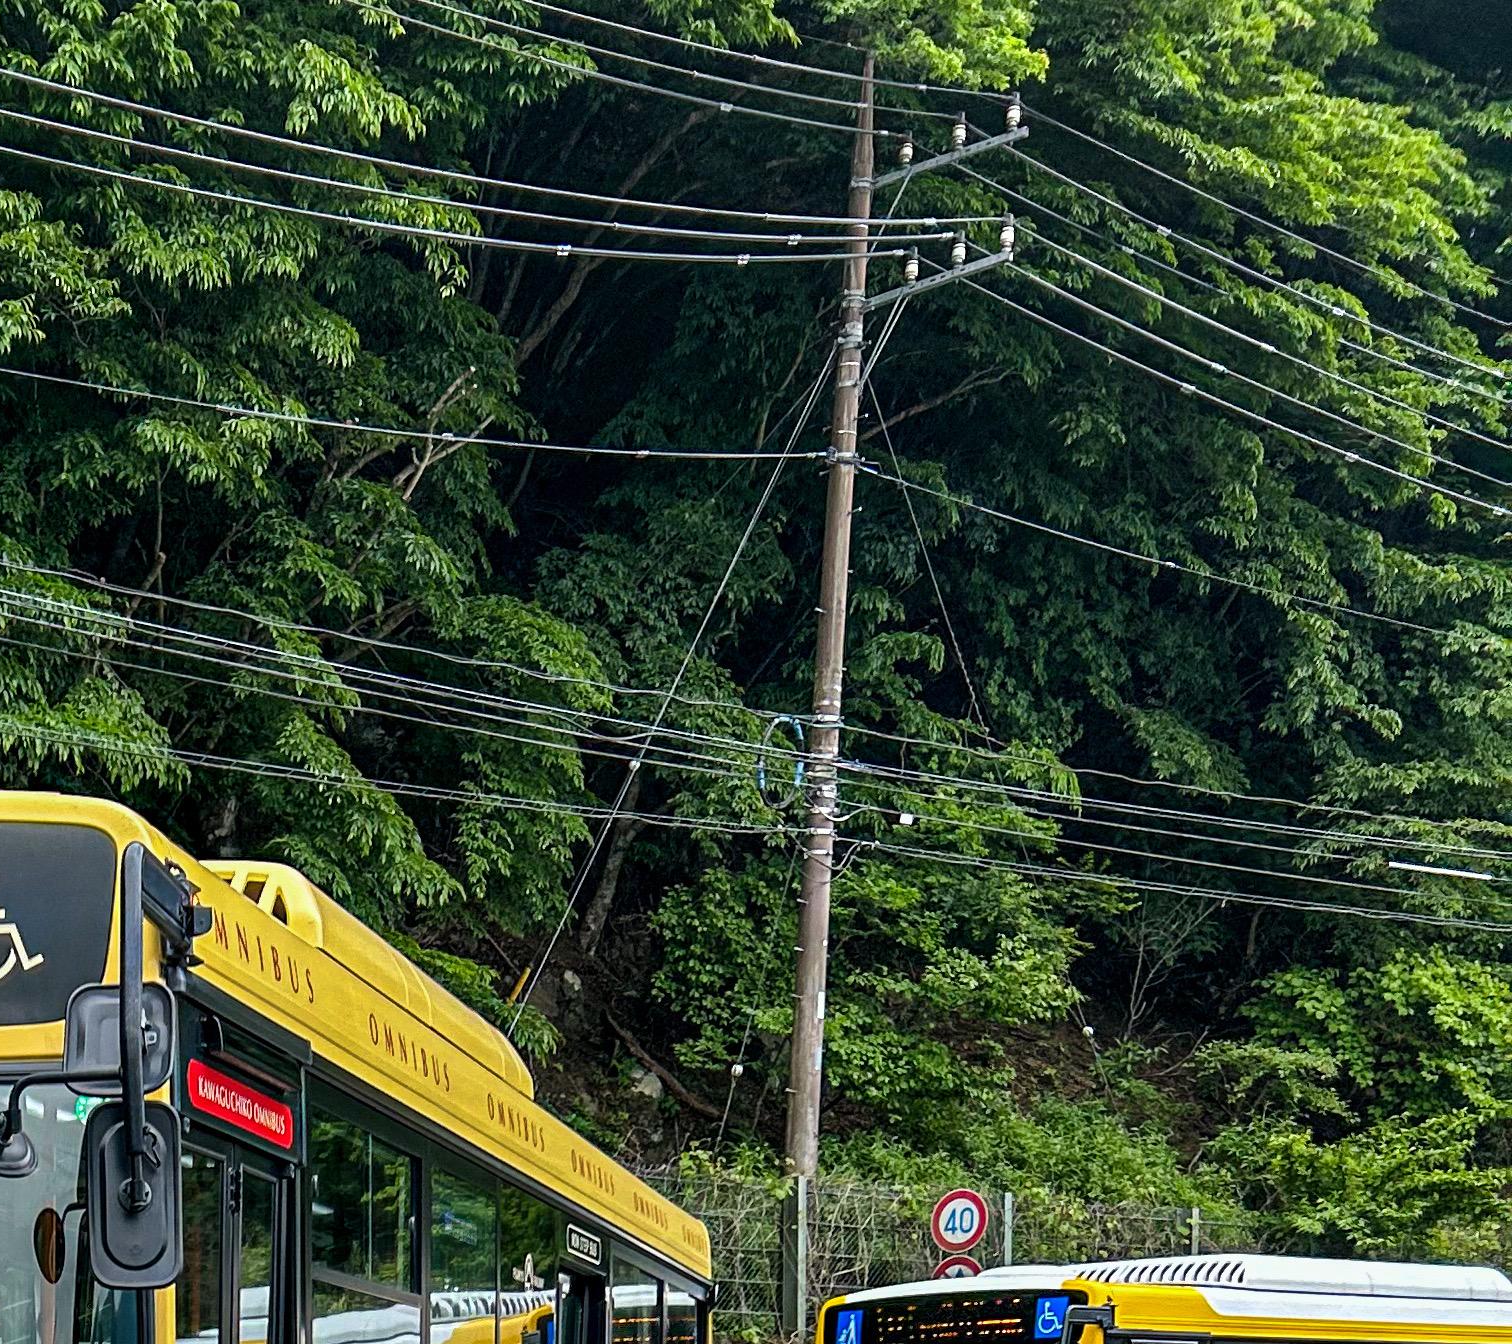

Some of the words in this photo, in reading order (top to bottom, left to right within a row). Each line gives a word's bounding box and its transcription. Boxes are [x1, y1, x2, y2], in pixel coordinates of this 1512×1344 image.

[212, 910, 315, 1005] MNIBUS
[368, 1012, 451, 1093] OMNIBUS
[197, 1074, 253, 1121] KAWAGUCHIKO
[253, 1102, 286, 1136] OMNIBUS
[487, 1092, 545, 1153] OMNIBUS
[943, 1206, 975, 1236] 40
